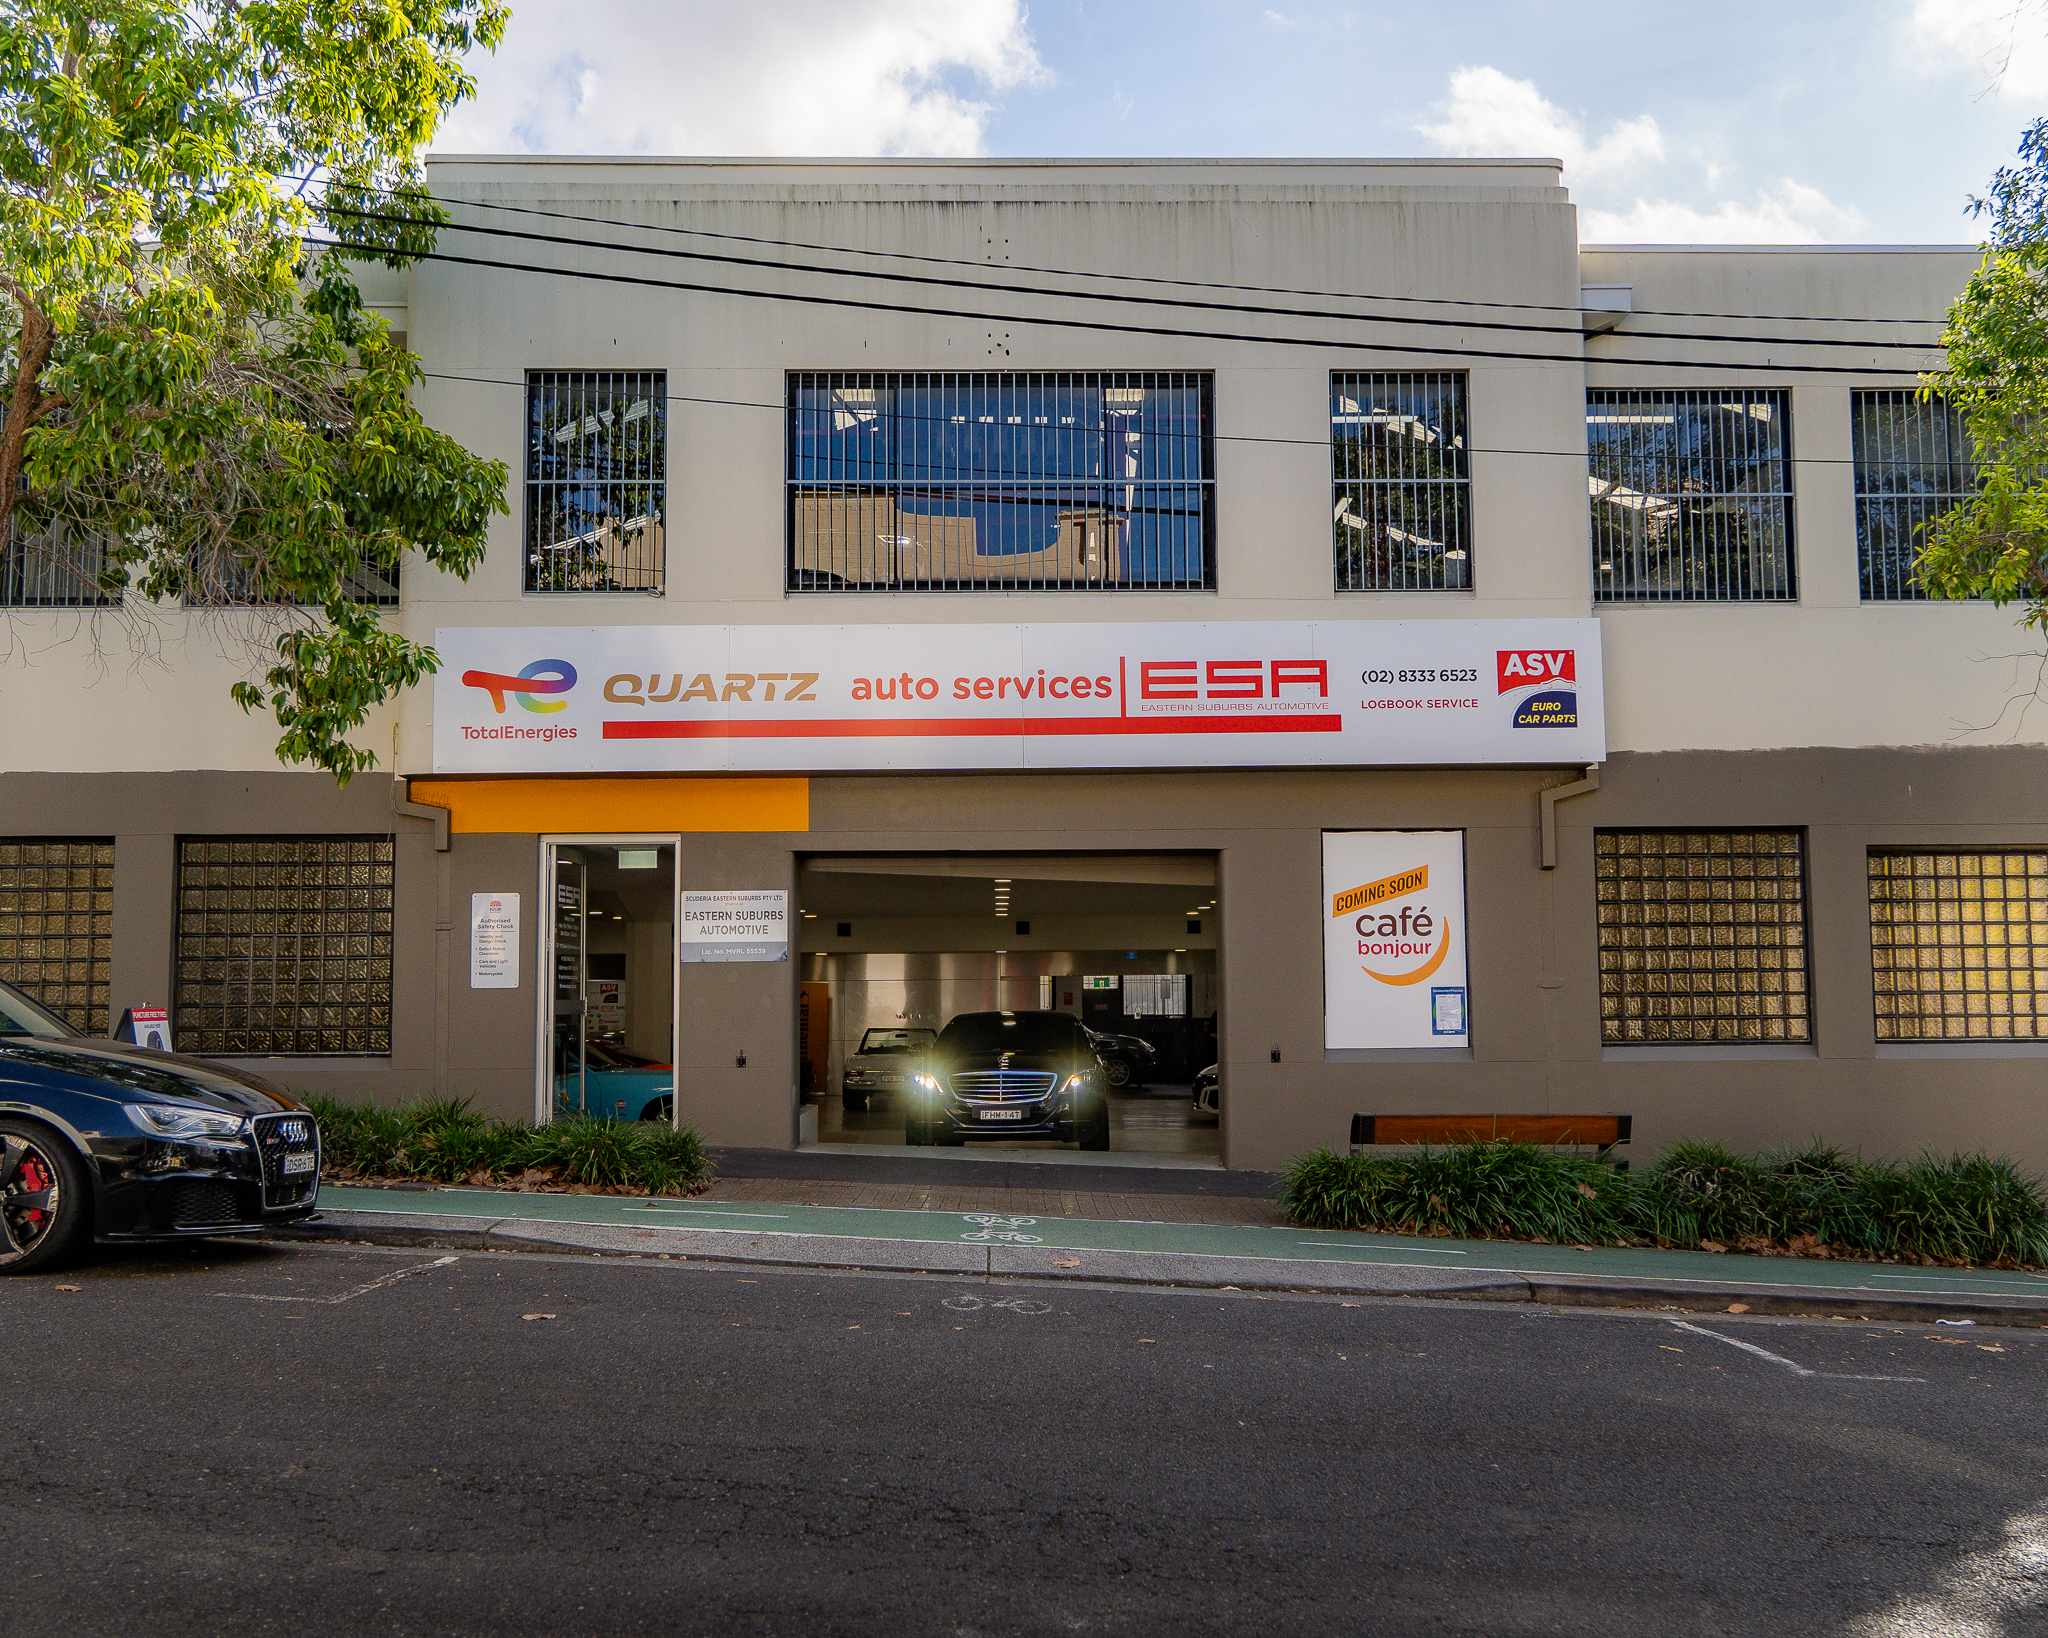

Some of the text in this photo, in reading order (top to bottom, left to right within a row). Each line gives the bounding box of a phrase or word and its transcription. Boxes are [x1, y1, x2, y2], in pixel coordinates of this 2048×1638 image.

[1503, 653, 1566, 676] ASV
[851, 668, 1113, 700] auto services
[1140, 660, 1328, 700] ESA
[1361, 669, 1477, 685] (02) 8333 6523
[603, 673, 819, 707] QUARTZ
[1141, 702, 1330, 712] EASTERN SUBURBS AUTOMOTIVE
[1361, 699, 1479, 709] LOGBOOK SERVICE
[1531, 702, 1561, 711] EURO
[1518, 714, 1576, 724] CAR PARTS
[461, 725, 578, 743] TotalEnergies
[1336, 872, 1423, 912] COMING SOON
[685, 910, 784, 921] EASTERN SUBURBS
[1355, 905, 1433, 937] café
[699, 925, 769, 935] AUTOMOTIVE
[1358, 940, 1432, 958] bonjour
